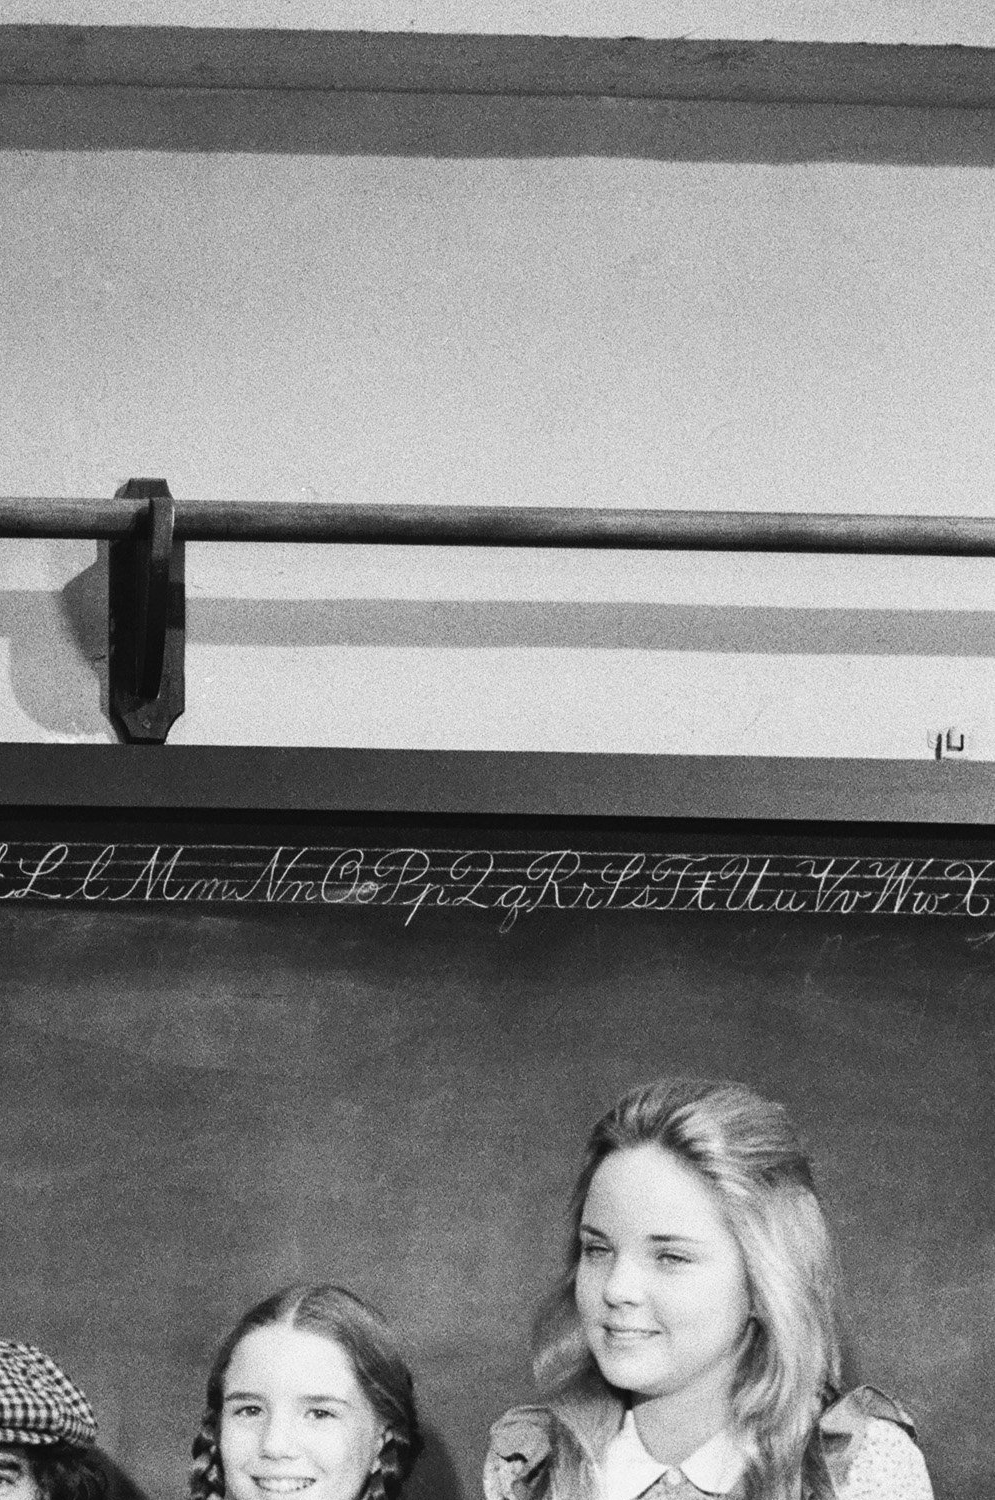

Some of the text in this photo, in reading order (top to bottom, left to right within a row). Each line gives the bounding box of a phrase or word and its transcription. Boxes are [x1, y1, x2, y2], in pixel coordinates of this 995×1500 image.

[109, 846, 243, 900] Mm
[235, 847, 318, 901] Nn
[374, 849, 450, 926] Pp
[527, 849, 602, 912] Rr
[652, 855, 717, 910] Tt
[720, 855, 806, 911] Uu
[796, 858, 871, 913] Vv
[869, 858, 950, 914] Ww
